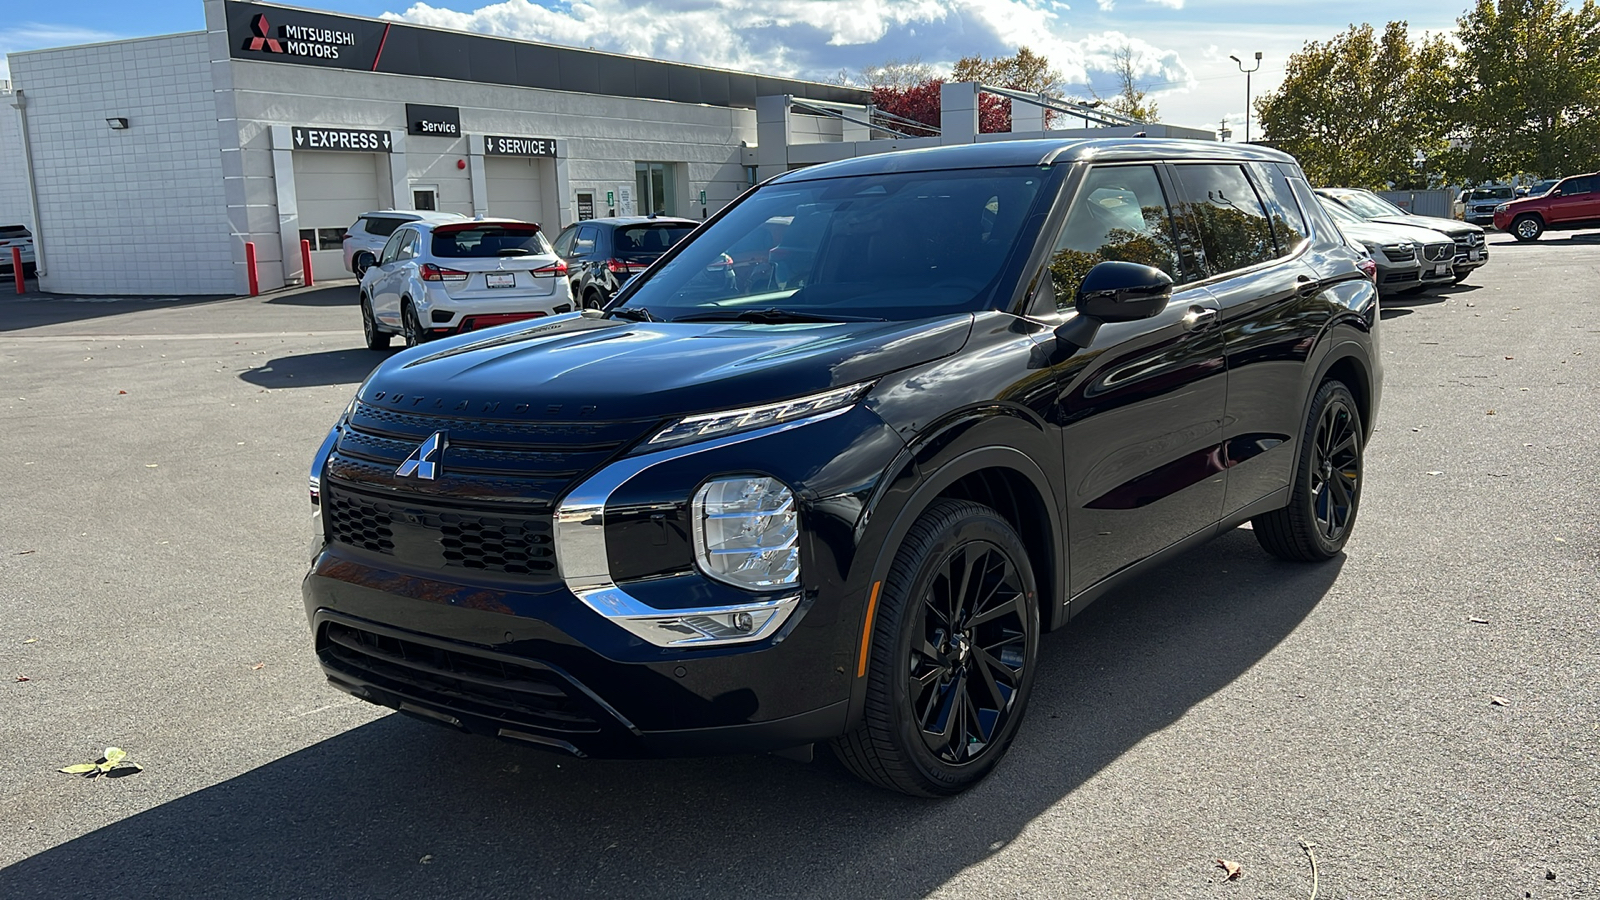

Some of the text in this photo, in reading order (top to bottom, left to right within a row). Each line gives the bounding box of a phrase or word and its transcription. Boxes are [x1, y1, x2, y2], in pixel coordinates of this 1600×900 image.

[285, 24, 355, 46] MITSUBISHI
[287, 41, 339, 59] MOTORS
[422, 120, 456, 133] Service
[308, 130, 379, 149] EXPRESS
[498, 138, 546, 155] SERVICE
[374, 391, 597, 416] OUTLANDER
